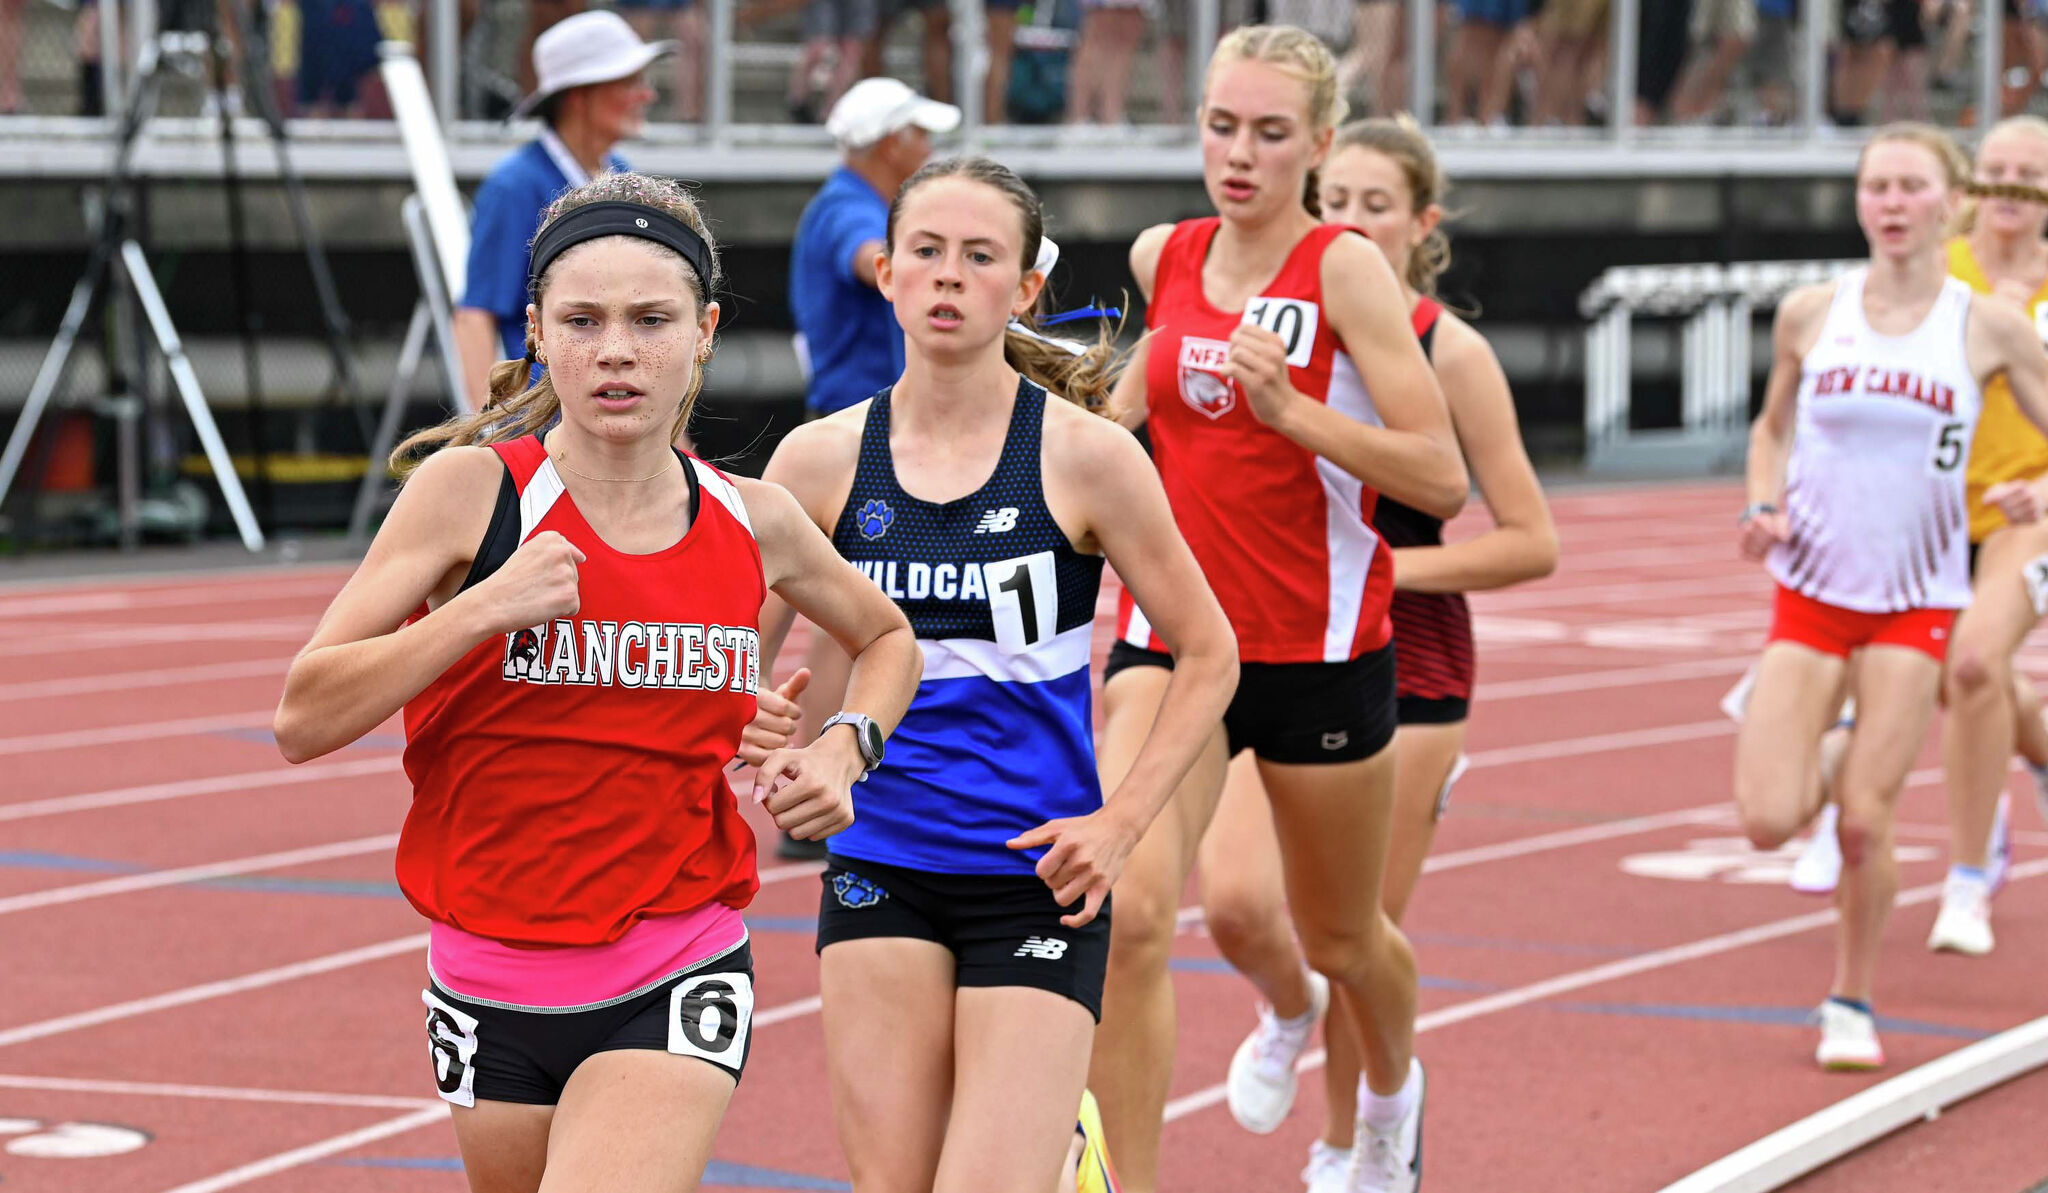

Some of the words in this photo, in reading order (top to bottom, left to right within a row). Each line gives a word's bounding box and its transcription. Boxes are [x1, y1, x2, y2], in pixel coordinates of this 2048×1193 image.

[1934, 423, 1964, 471] 5
[999, 563, 1039, 646] 1
[428, 1006, 467, 1094] 6
[680, 979, 738, 1053] 6
